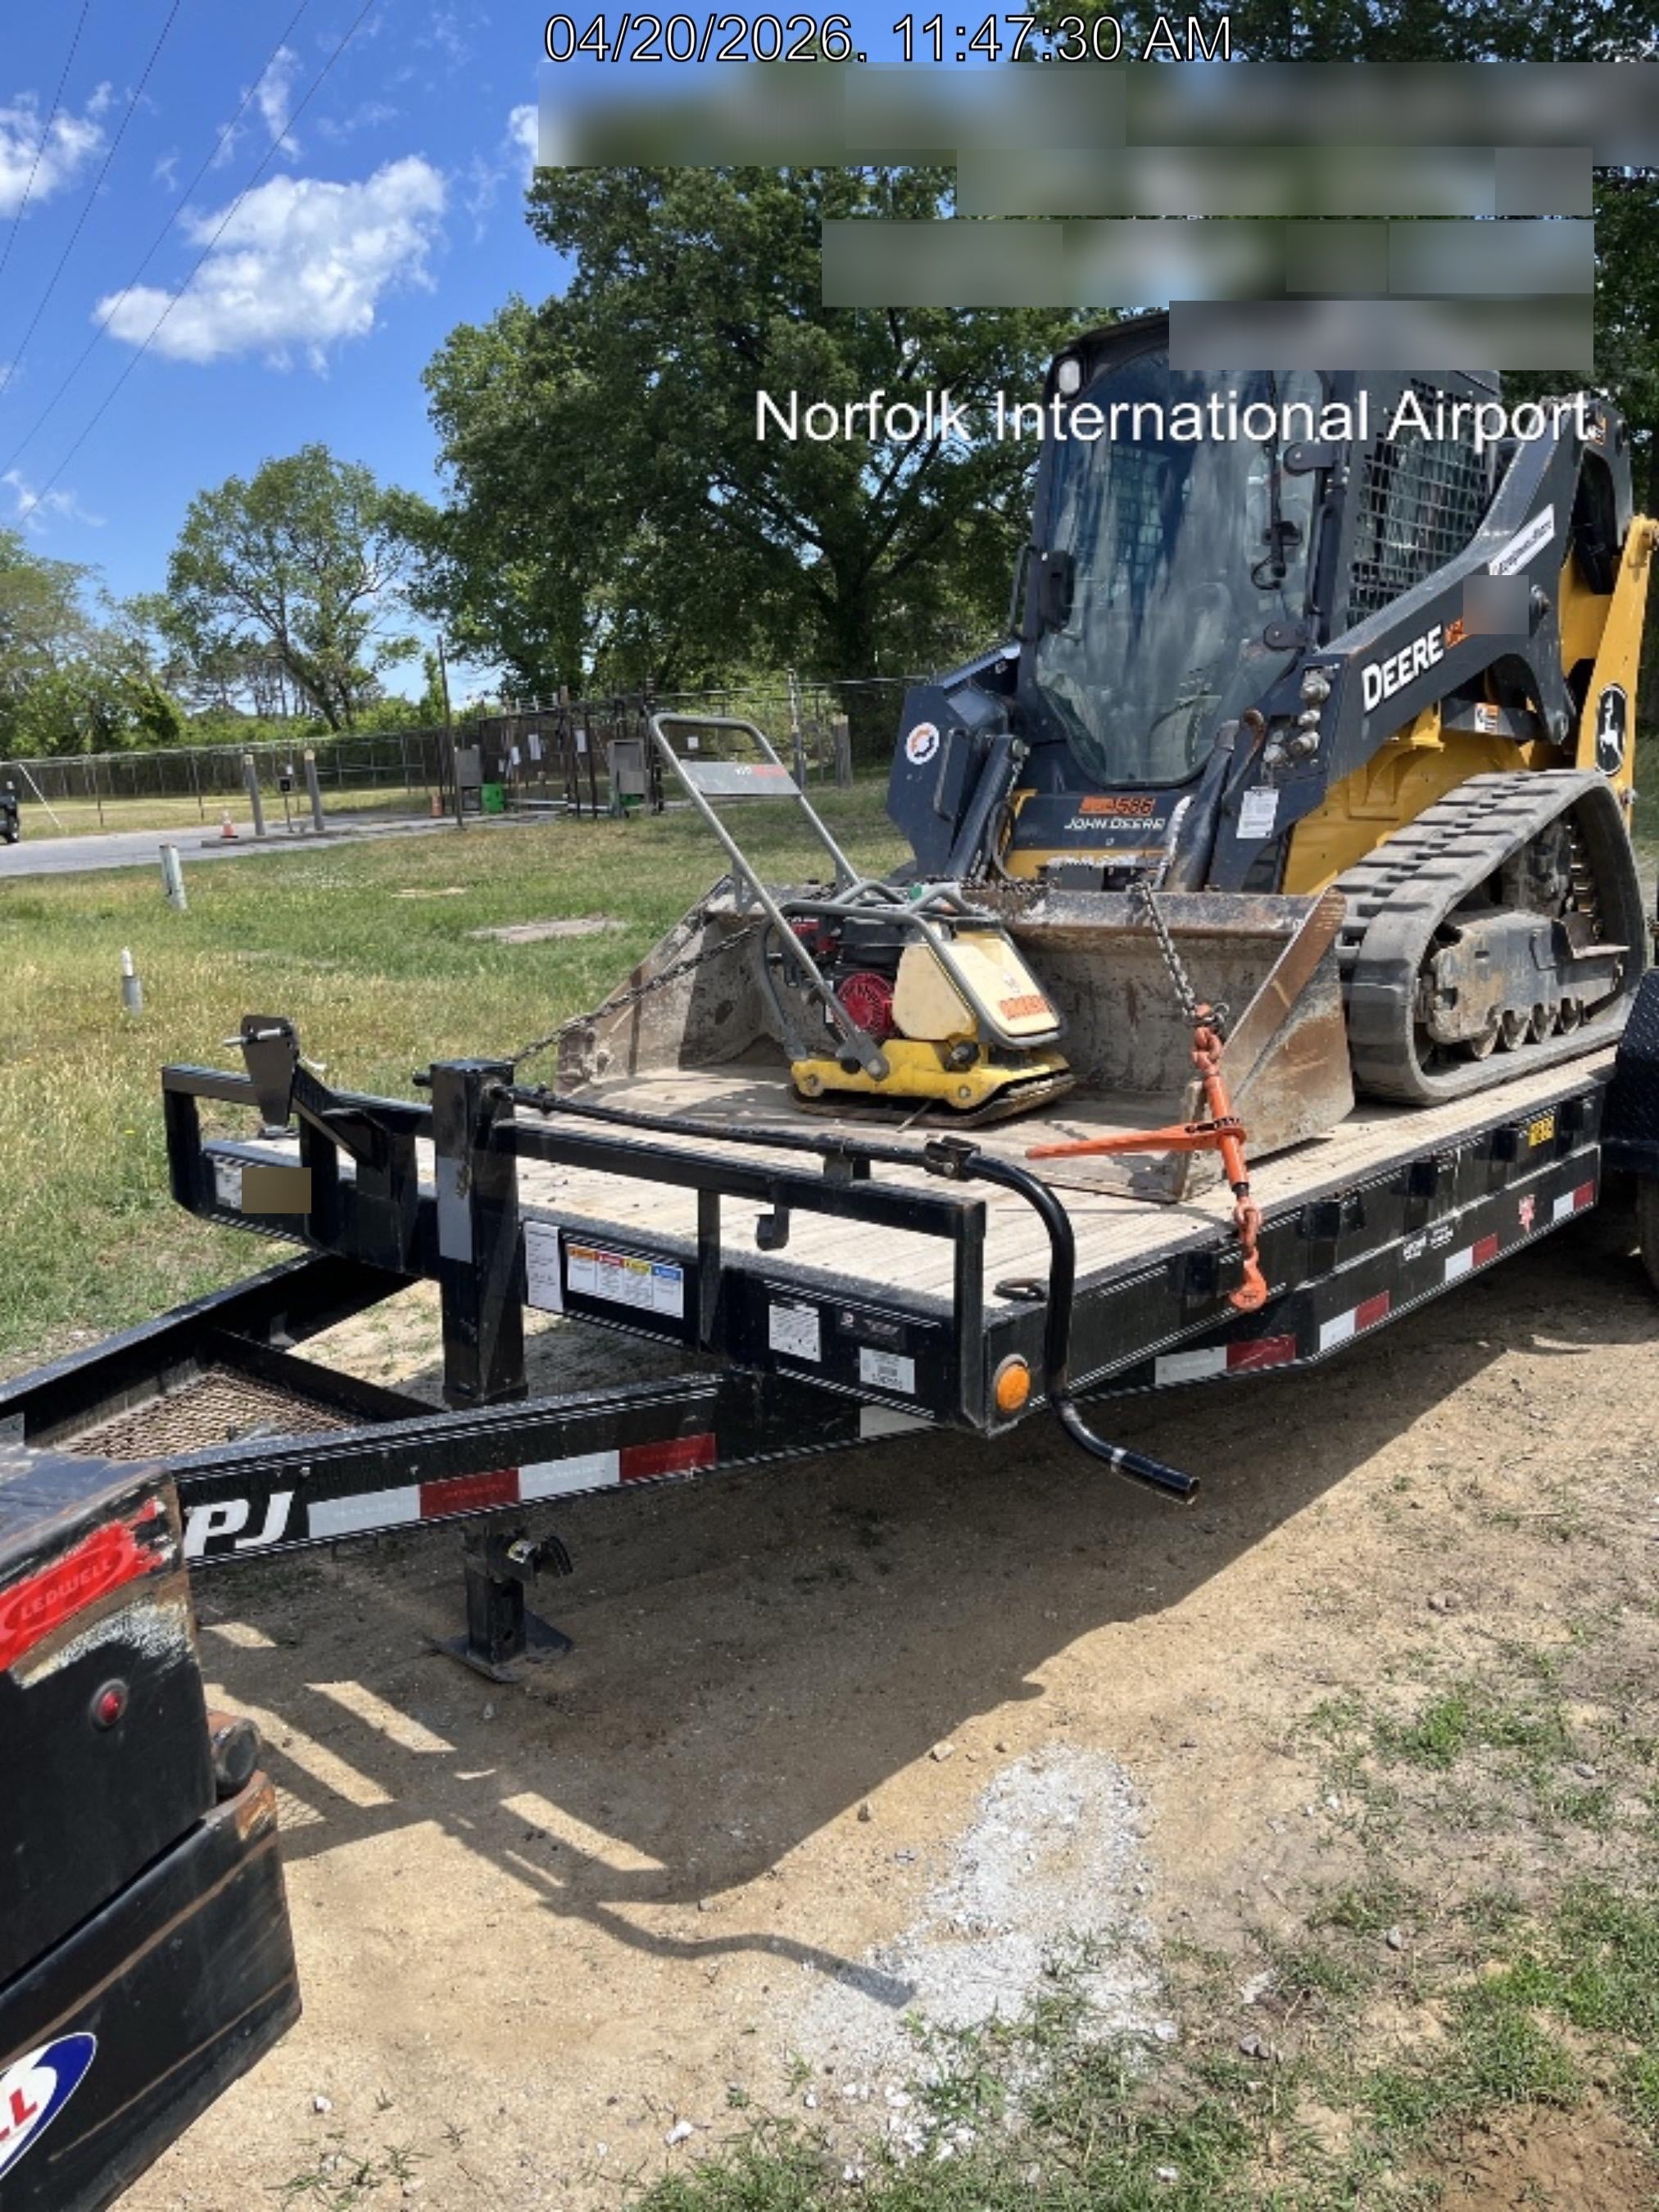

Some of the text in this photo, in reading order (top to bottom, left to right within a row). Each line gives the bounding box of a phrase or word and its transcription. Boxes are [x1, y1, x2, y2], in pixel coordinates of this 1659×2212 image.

[1362, 624, 1444, 712] DEERE
[1064, 818, 1165, 831] JOHN DEERE
[183, 1491, 295, 1557] PJ
[20, 1558, 111, 1620] LEDWELL
